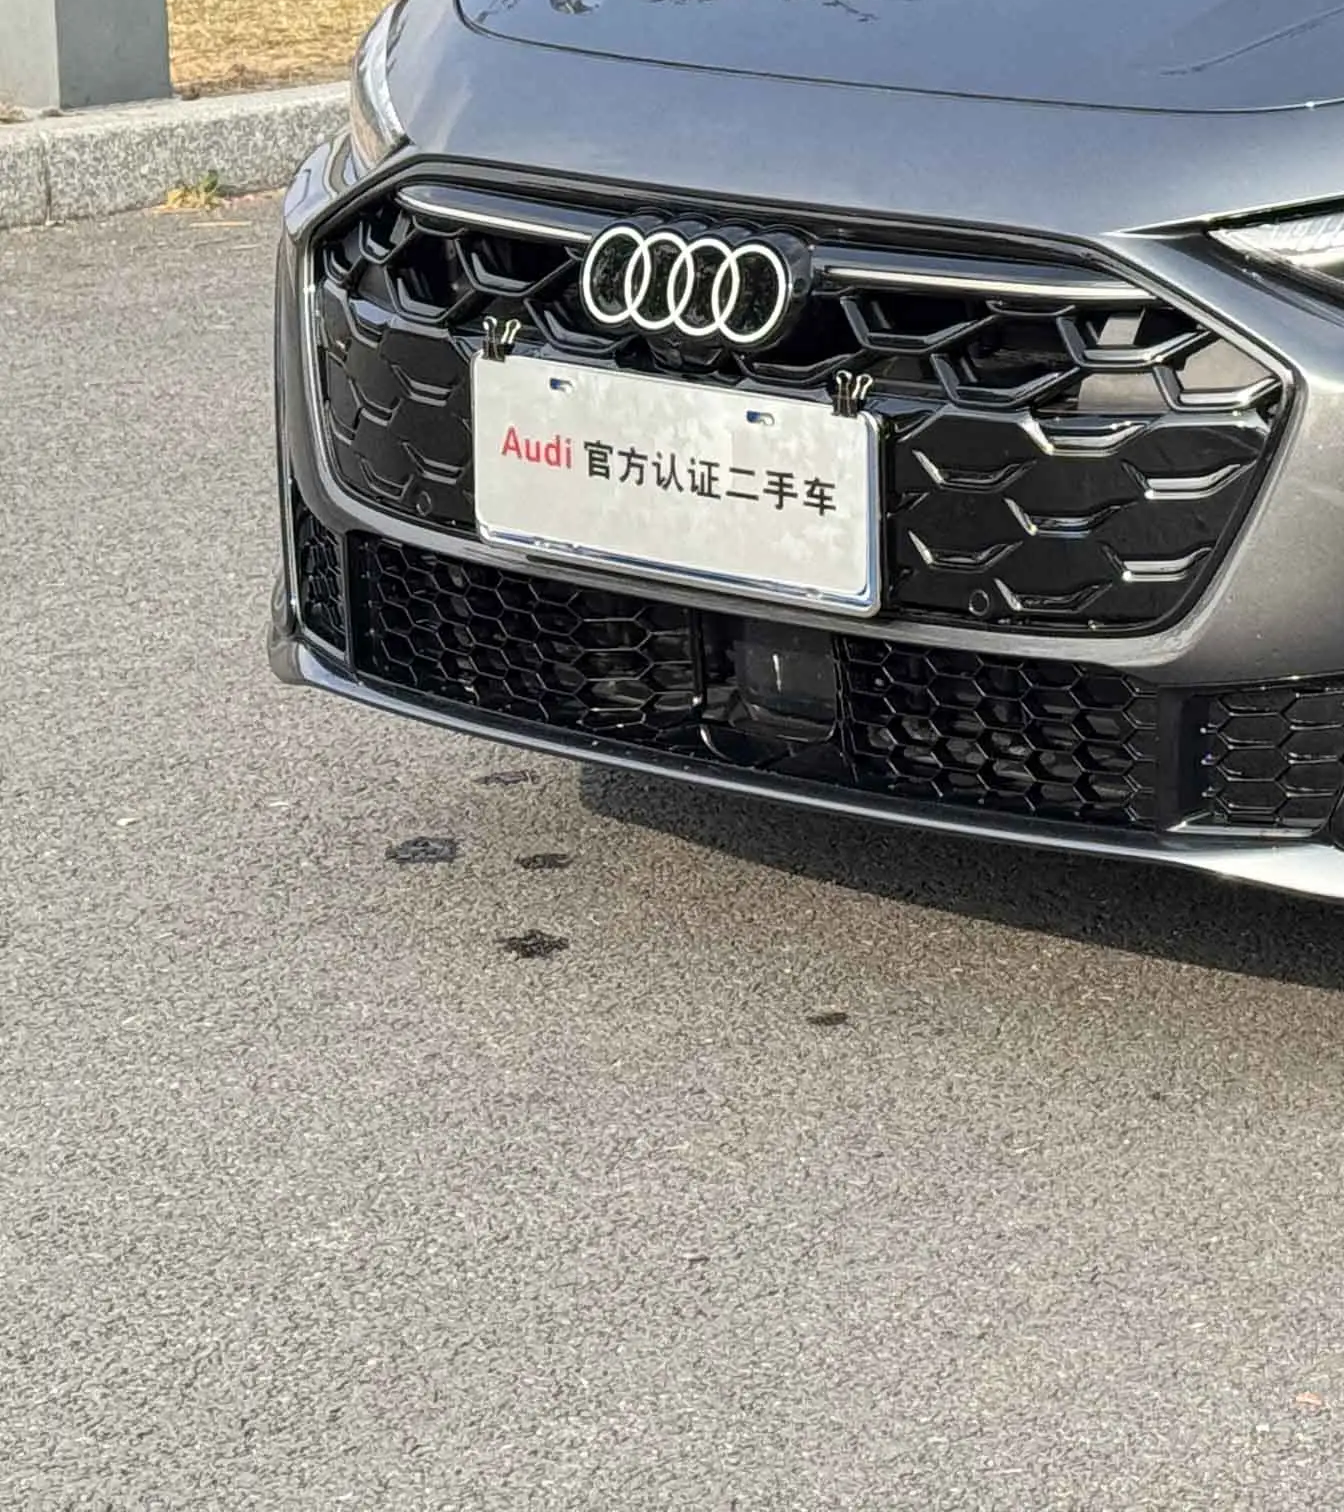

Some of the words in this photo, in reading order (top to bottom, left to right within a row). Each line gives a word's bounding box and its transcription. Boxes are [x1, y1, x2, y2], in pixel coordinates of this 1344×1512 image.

[502, 426, 572, 468] Audi
[584, 440, 837, 516] 官方认证二手车
